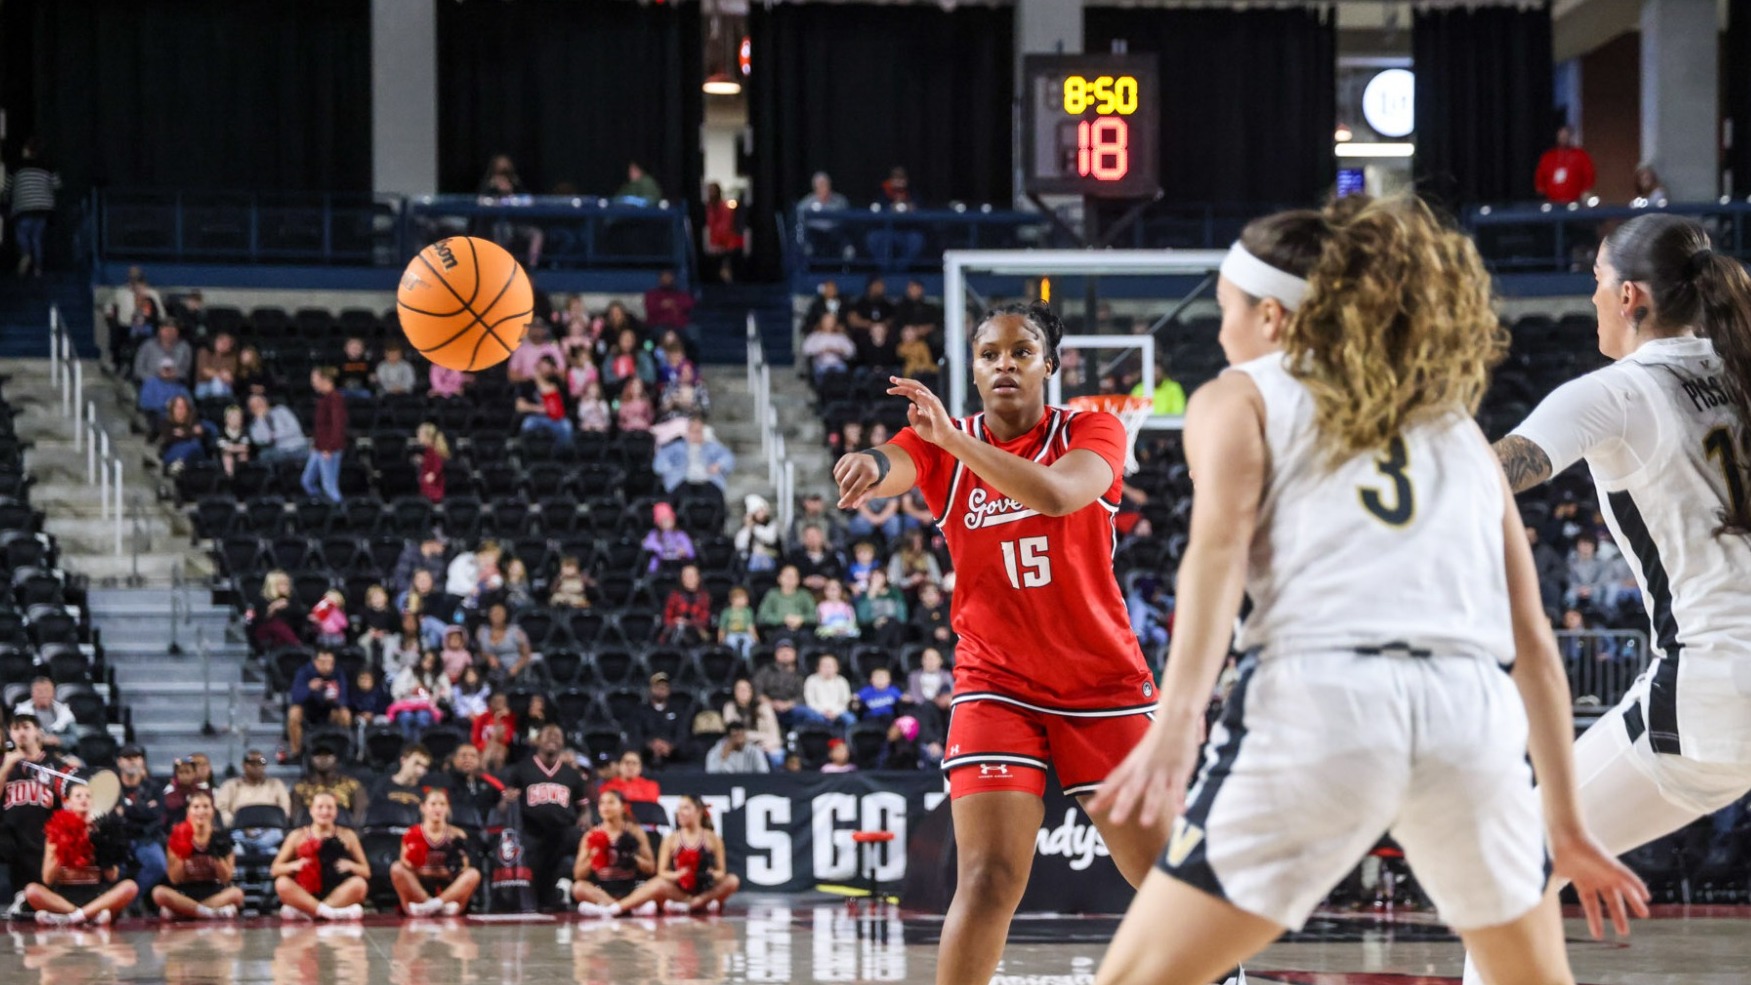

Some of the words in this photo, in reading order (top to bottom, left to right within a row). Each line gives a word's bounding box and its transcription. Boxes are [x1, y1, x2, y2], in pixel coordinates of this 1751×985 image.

[1064, 76, 1138, 115] 8:50
[1078, 116, 1128, 181] 18
[1682, 375, 1736, 412] PISS
[1357, 434, 1414, 528] 3
[1703, 422, 1747, 514] 1
[963, 487, 1024, 530] Gove
[1000, 535, 1052, 590] 15
[811, 791, 907, 882] GO
[1035, 807, 1110, 870] ndys
[1166, 815, 1205, 867] V
